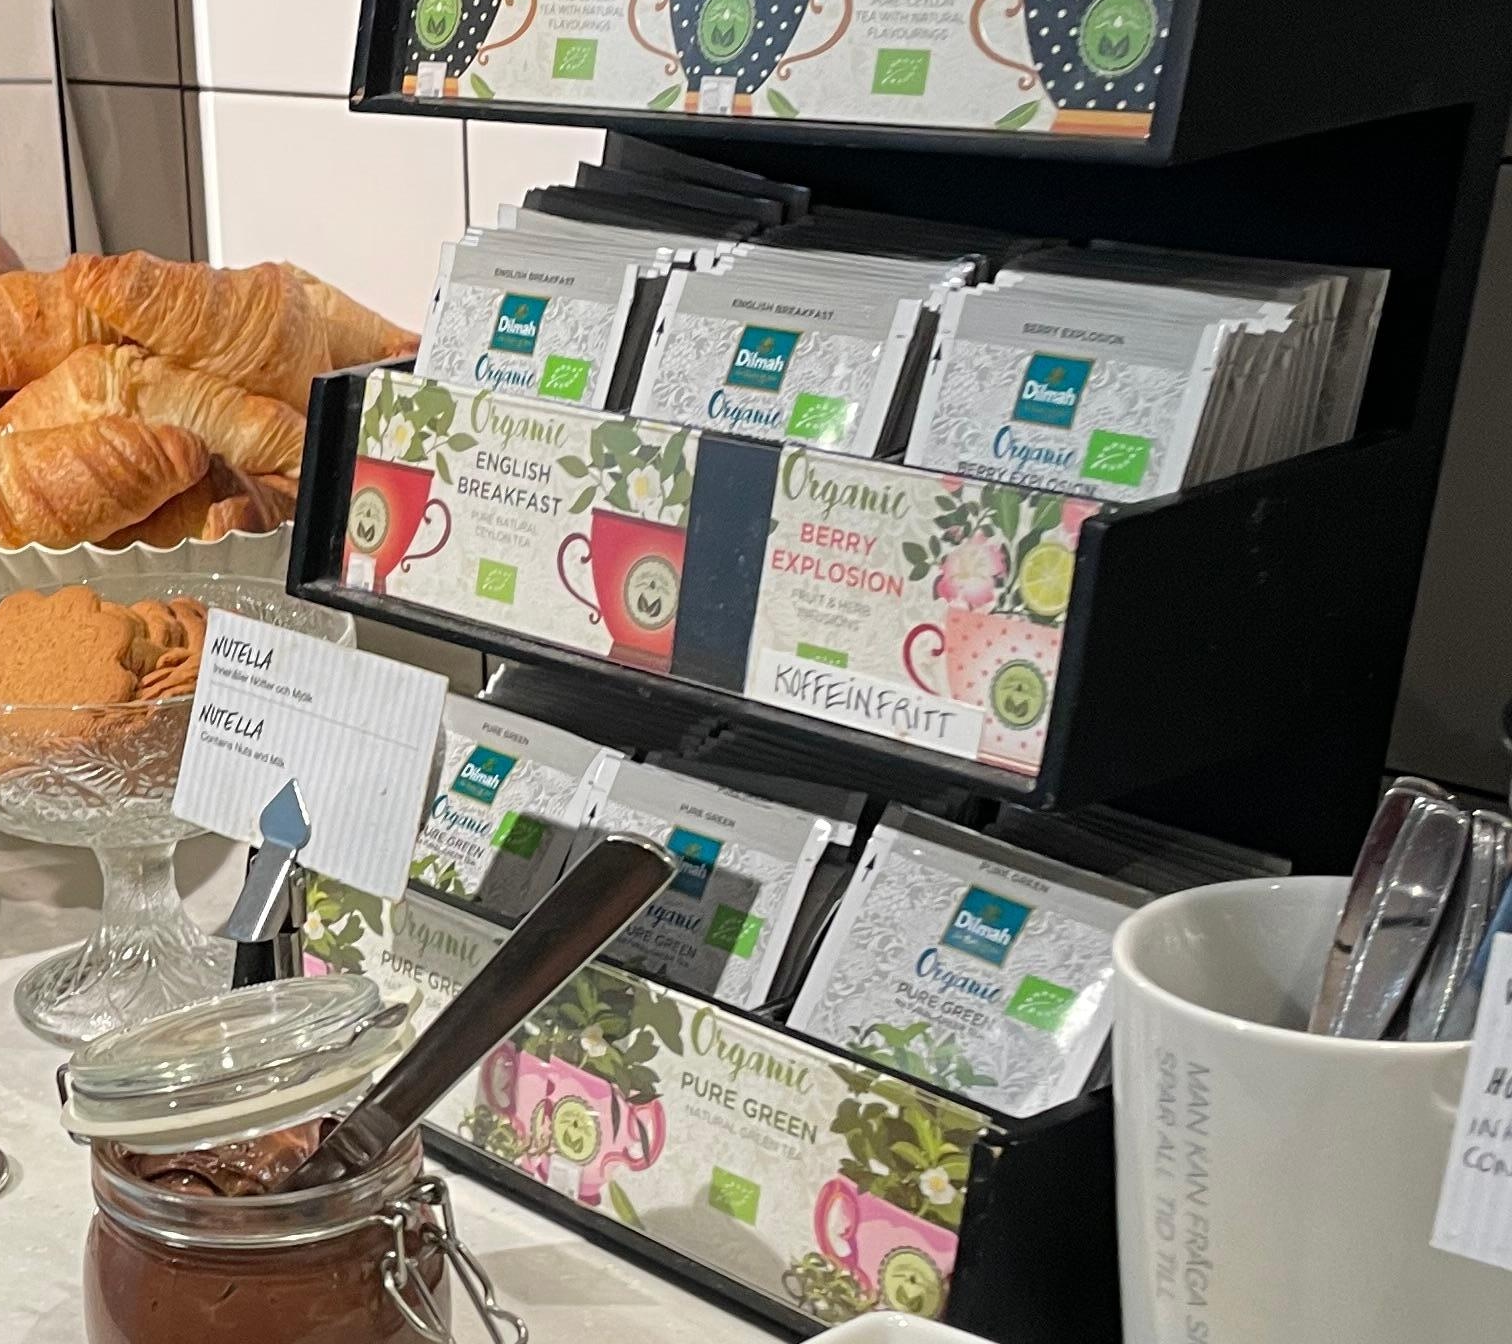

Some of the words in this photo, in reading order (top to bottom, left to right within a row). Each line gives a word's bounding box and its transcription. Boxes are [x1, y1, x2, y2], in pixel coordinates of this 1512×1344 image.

[498, 316, 536, 337] Dilmah
[732, 299, 774, 312] ENGLISH
[775, 305, 834, 321] BREAKFAST
[1023, 322, 1058, 338] BERRY
[475, 353, 535, 390] Organic
[736, 349, 785, 372] Dilmah
[708, 389, 781, 429] Organic
[1023, 380, 1077, 406] Dilmah
[471, 389, 567, 451] Organic
[994, 425, 1075, 471] Organic
[476, 451, 552, 484] ENGLISH
[782, 448, 912, 520] Organic
[457, 476, 562, 516] BREAKFAST
[800, 522, 878, 555] BERRY
[771, 549, 905, 597] EXPLOSION
[211, 636, 274, 671] NUTELLA
[774, 664, 957, 738] KOFFEINFRITT
[199, 703, 264, 741] NUTELLA
[482, 722, 501, 737] PURE
[462, 763, 500, 790] Dilmah
[424, 824, 444, 843] URE
[431, 794, 493, 836] Organic
[680, 803, 703, 819] PURE
[704, 811, 736, 828] GREEN
[646, 904, 702, 933] rganic
[955, 910, 1011, 946] Dilmah
[381, 950, 426, 983] PURE
[428, 972, 463, 997] GRE
[916, 948, 1003, 1004] Organic
[897, 982, 938, 1009] PURE
[691, 1006, 814, 1095] Organic
[681, 1072, 737, 1110] PURE
[743, 1098, 818, 1145] GREEN
[1186, 1060, 1211, 1137] MAN
[1185, 1139, 1209, 1206] KAN
[1185, 1211, 1213, 1307] FRÅGA
